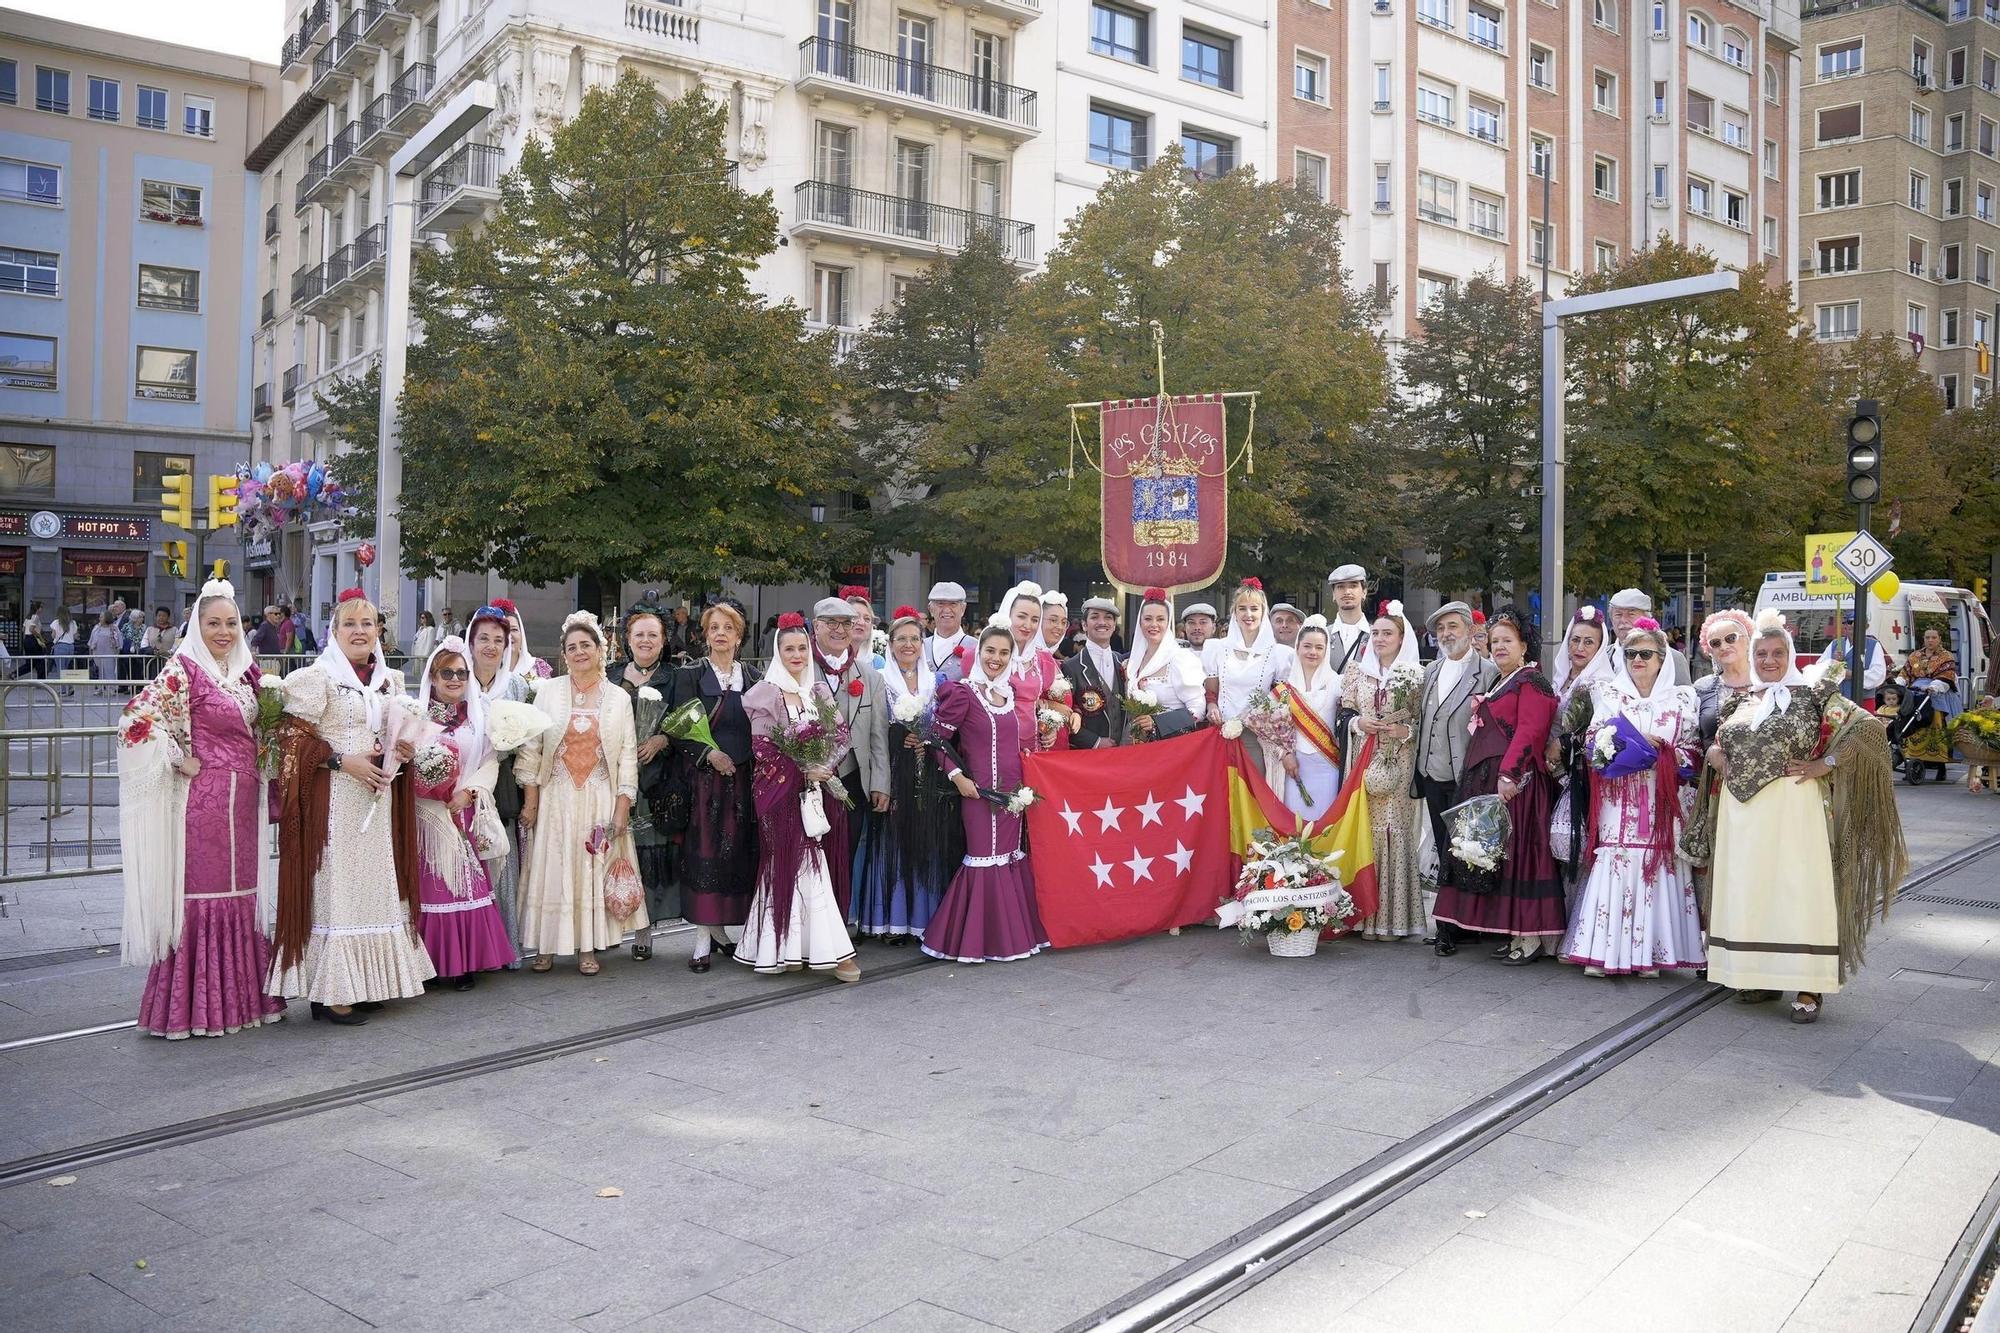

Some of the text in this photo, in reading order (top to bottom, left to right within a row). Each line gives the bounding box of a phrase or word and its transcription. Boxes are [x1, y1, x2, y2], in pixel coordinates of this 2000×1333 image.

[1108, 433, 1136, 458] LOS
[77, 522, 119, 533] HOT POT
[1146, 551, 1188, 567] 1984
[1849, 548, 1876, 567] 30
[1272, 895, 1289, 903] LOS
[1291, 891, 1328, 902] CASTIZOS
